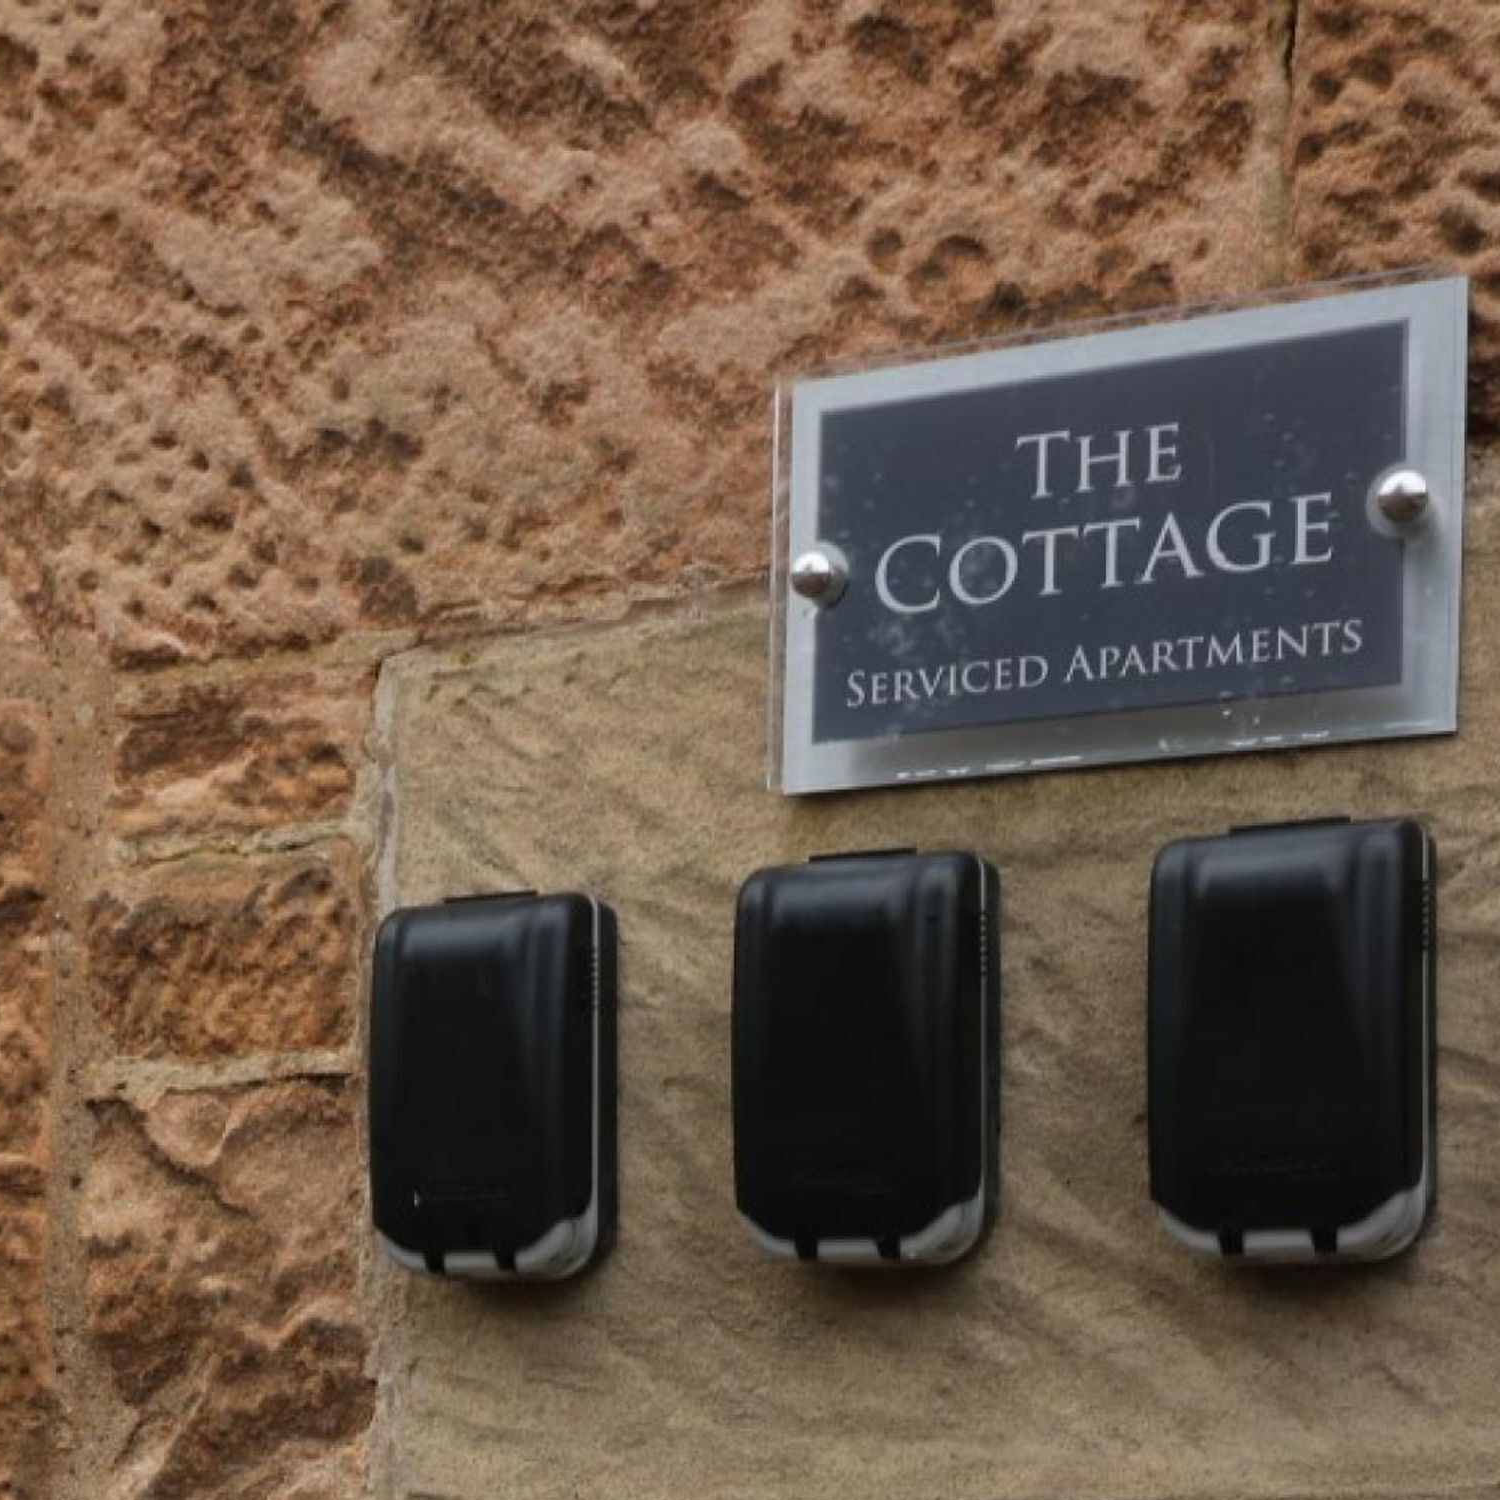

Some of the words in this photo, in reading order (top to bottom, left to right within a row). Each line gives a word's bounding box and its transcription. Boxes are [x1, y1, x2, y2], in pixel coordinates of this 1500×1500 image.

[1016, 422, 1182, 498] THE
[875, 491, 1333, 613] COTTAGE
[845, 653, 1049, 708] SERVICED
[1065, 618, 1363, 682] APARTMENTS
